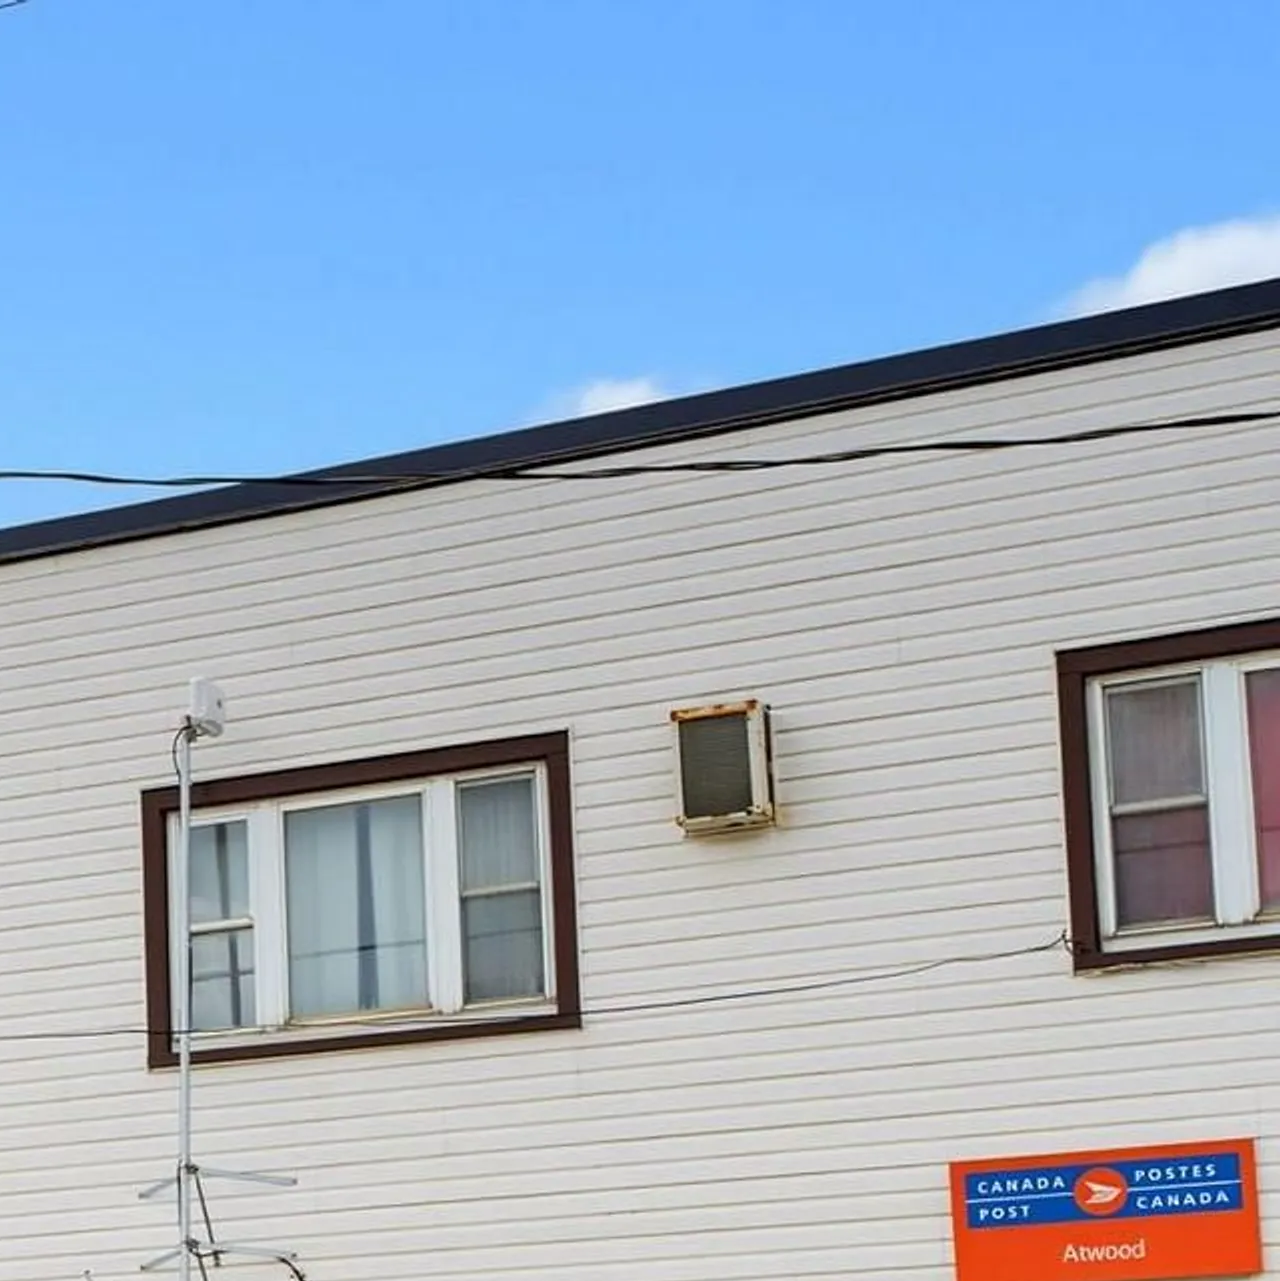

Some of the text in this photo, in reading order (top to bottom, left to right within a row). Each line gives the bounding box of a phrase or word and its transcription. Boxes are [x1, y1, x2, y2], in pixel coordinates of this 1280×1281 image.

[1134, 1163, 1217, 1183] POSTES
[976, 1175, 1066, 1195] CANADA
[1136, 1189, 1230, 1210] CANADA
[979, 1204, 1031, 1221] POST
[1062, 1238, 1147, 1263] Atwood
